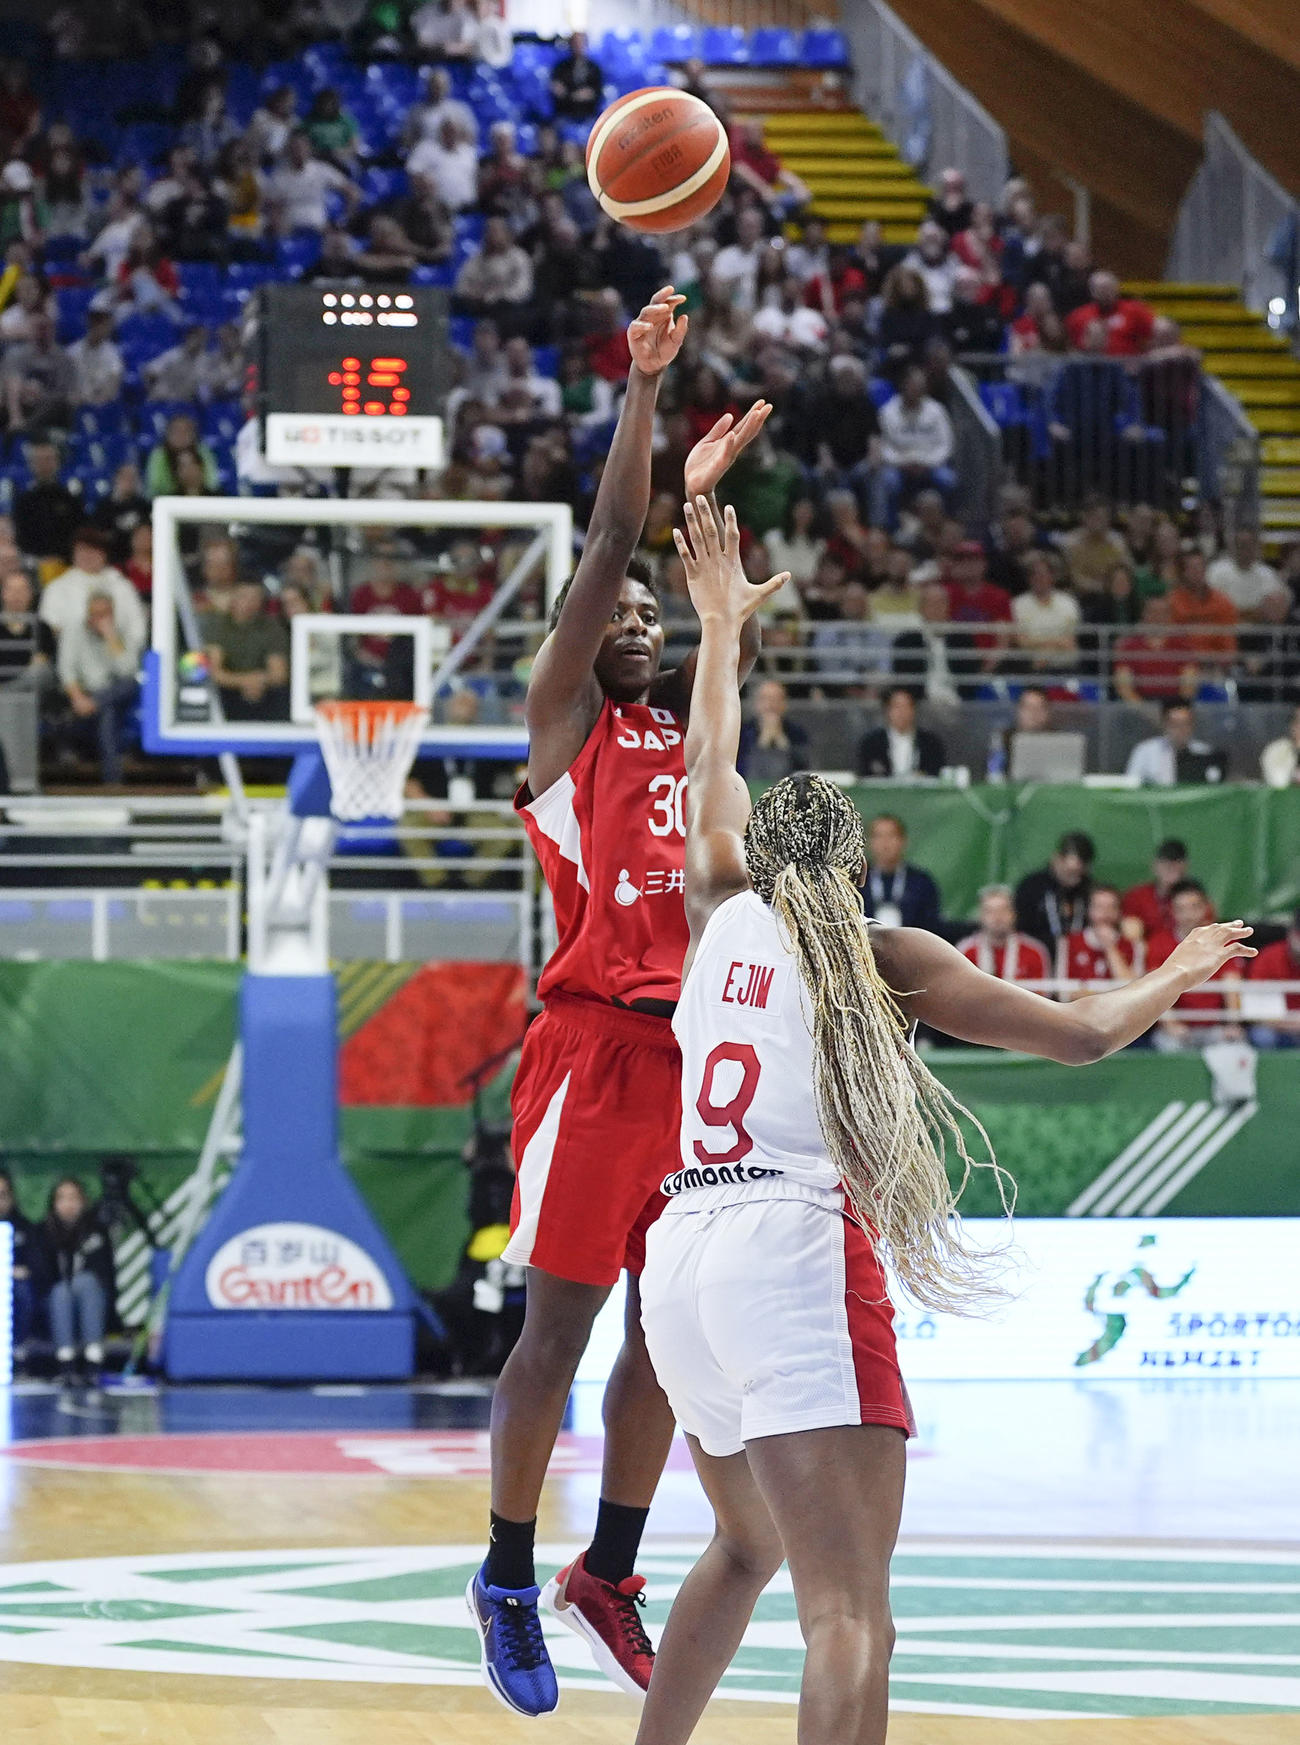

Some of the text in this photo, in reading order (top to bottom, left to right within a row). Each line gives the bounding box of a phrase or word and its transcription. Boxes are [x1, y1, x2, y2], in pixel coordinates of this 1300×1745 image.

[327, 427, 422, 444] TISSOT
[721, 961, 776, 1010] EJIM
[692, 1041, 762, 1166] 9
